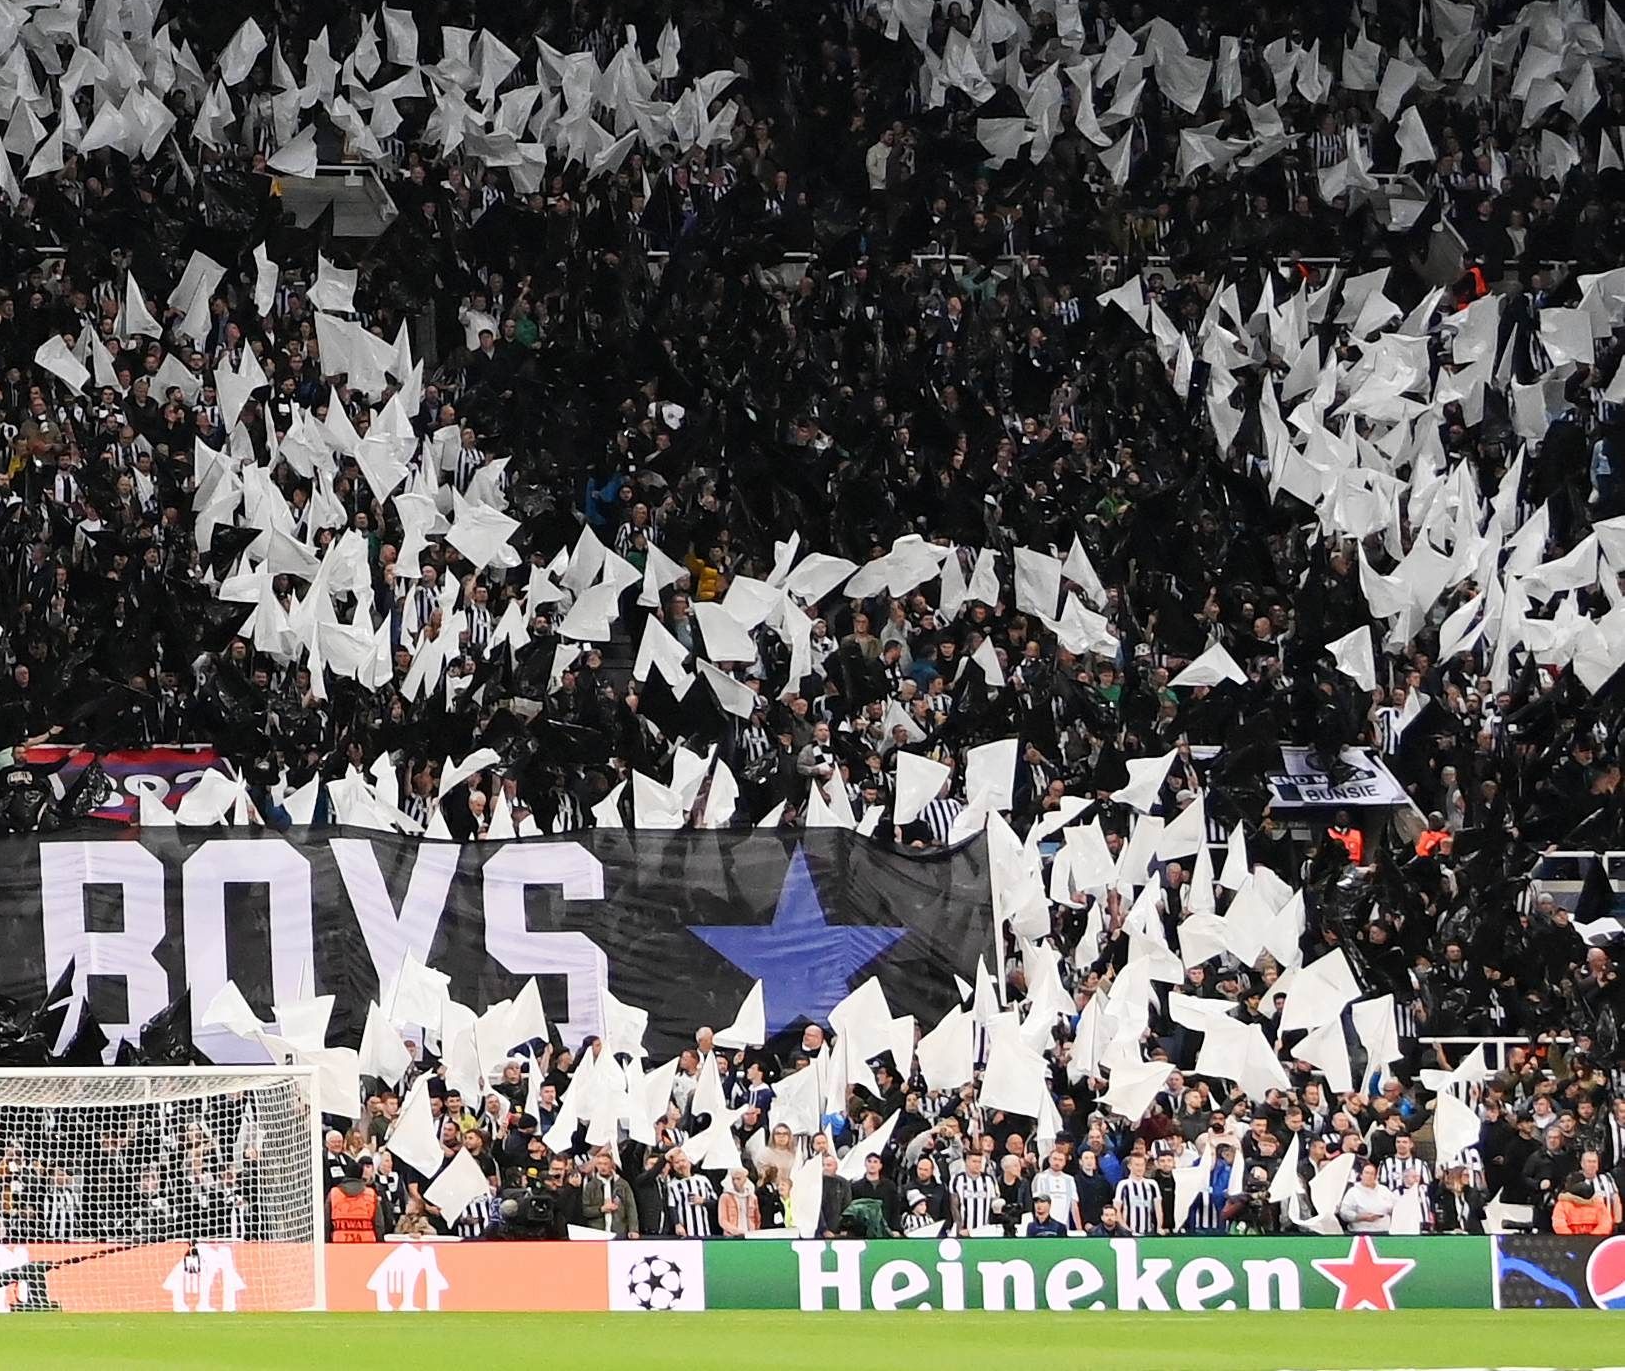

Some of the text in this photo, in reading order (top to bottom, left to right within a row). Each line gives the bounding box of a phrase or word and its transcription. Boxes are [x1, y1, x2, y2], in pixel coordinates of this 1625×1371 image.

[1306, 785, 1380, 801] BUNSIE
[40, 840, 607, 1064] BOYS
[793, 1239, 1301, 1311] Heineken
